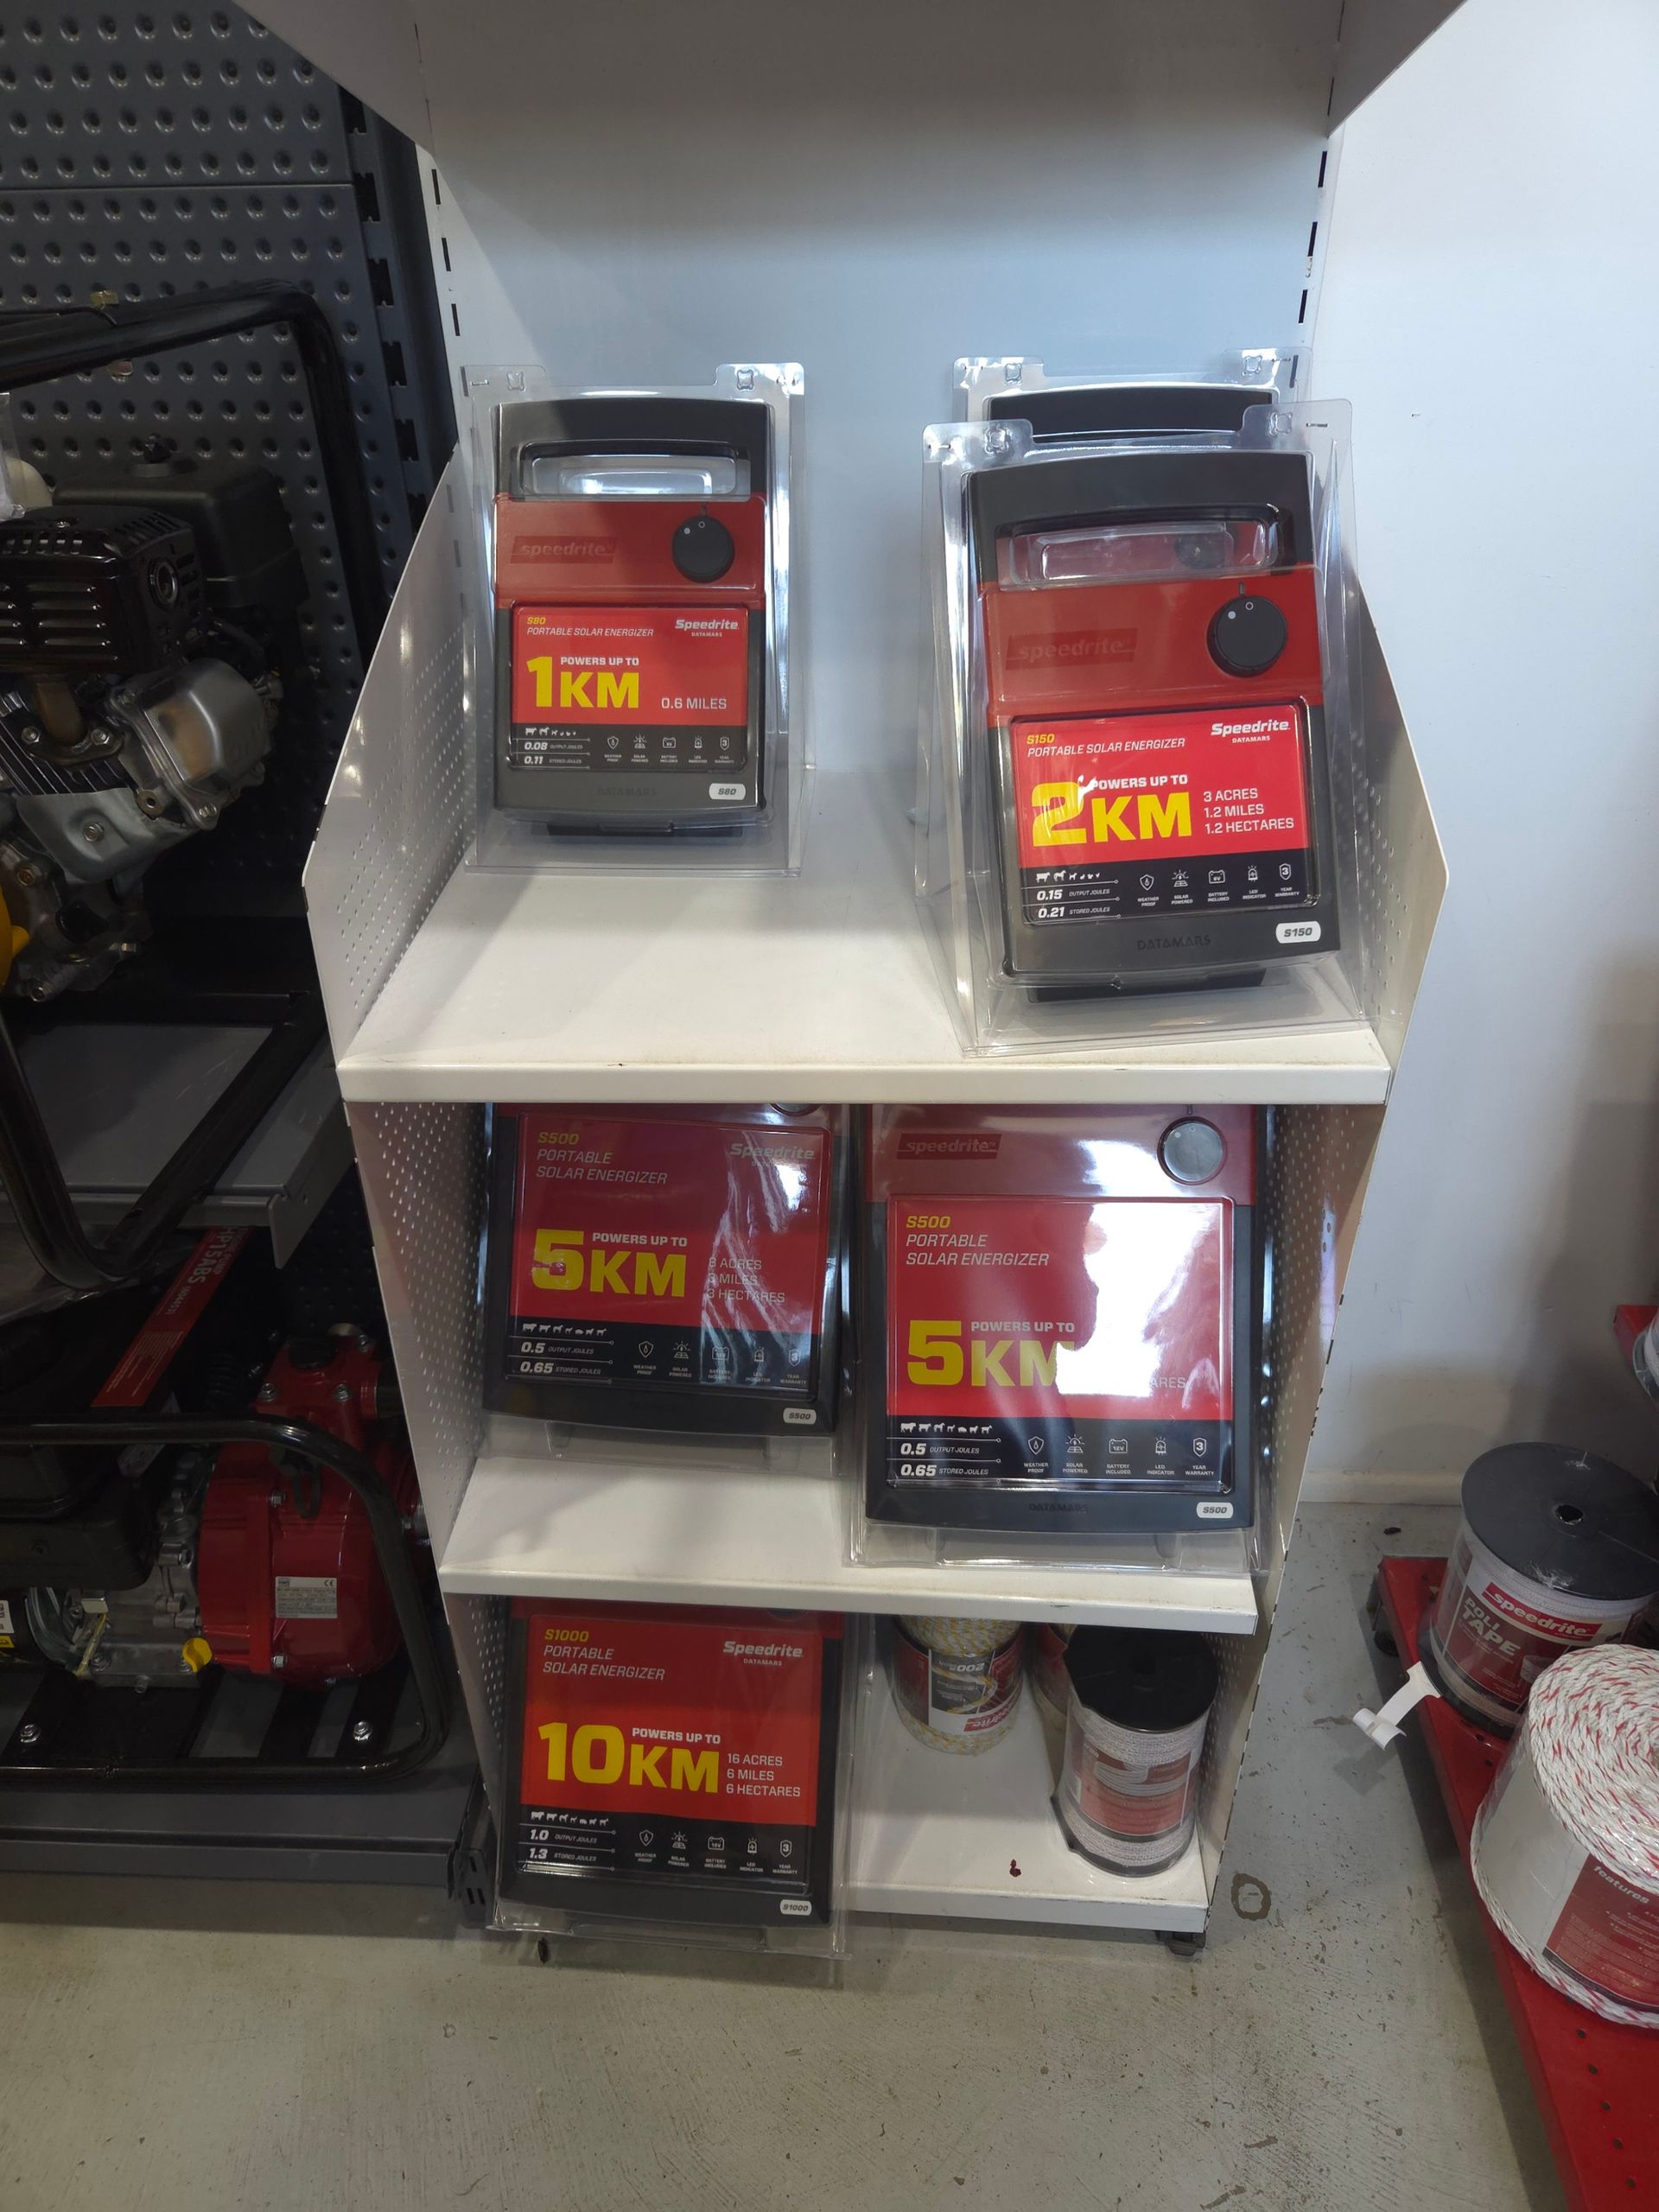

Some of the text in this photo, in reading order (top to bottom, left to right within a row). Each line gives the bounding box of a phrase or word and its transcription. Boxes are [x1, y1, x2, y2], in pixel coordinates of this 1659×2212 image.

[522, 543, 606, 559] speedrite
[527, 616, 546, 626] S80
[675, 619, 740, 632] Speedrite
[527, 627, 572, 636] PORTABLE
[605, 628, 654, 637] ENERGIZER
[1018, 637, 1123, 663] speedrite
[561, 657, 639, 666] POWERS UP TO
[661, 697, 727, 709] 0.6 MILES
[1211, 720, 1290, 737] Speedrite
[1027, 734, 1055, 744] S150
[524, 741, 548, 751] 0.08
[1027, 738, 1185, 758] PORTABLE SOLAR ENERGIZER
[524, 755, 543, 765] 0.11
[1092, 774, 1188, 791] POWERS UP TO
[1204, 788, 1258, 802] 3 ACRES
[1204, 804, 1264, 818] 1.2 MILES
[1205, 817, 1294, 835] 1.2 HECTARES
[1281, 867, 1289, 875] 3
[1036, 889, 1063, 901] 0.15
[1038, 906, 1065, 918] 0.21
[1283, 927, 1313, 938] S150
[1137, 934, 1211, 950] DATAMARS
[537, 1132, 580, 1145] S500
[730, 1142, 815, 1160] Speedrite
[906, 1139, 989, 1154] speedrite
[537, 1148, 613, 1164] PORTABLE
[536, 1166, 668, 1185] SOLAR ENERGIZER
[906, 1215, 951, 1229] S500
[592, 1232, 688, 1247] POWERS UP TO
[906, 1234, 988, 1247] PORTABLE
[709, 1257, 762, 1270] 8 ACRES
[906, 1252, 1050, 1266] SOLAR ENERGIZER
[708, 1272, 758, 1285] 3 MILES
[707, 1288, 785, 1303] 3 HECTARES
[971, 1321, 1075, 1332] POWERS UP TO
[520, 1342, 594, 1355] 0.5 OUTPUT JOULES
[791, 1352, 798, 1361] 3
[519, 1361, 555, 1374] 0.65
[788, 1411, 811, 1420] S500
[900, 1442, 927, 1455] 0.5
[1196, 1442, 1204, 1452] 3
[900, 1464, 938, 1477] 0.65
[1465, 1597, 1500, 1631] POLI
[1493, 1593, 1588, 1635] speedrite
[544, 1629, 589, 1642] S1000
[1462, 1605, 1521, 1656] TAPE
[543, 1645, 614, 1660] PORTABLE
[722, 1641, 804, 1658] Speedrite
[543, 1662, 665, 1681] SOLAR ENERGIZER
[632, 1727, 721, 1745] POWERS UP TO
[727, 1752, 783, 1766] 16 ACRES
[727, 1769, 774, 1781] 6 MILES
[726, 1783, 801, 1797] 6 HECTARES
[530, 1828, 550, 1840] 1.0
[529, 1847, 549, 1859] 1.3
[782, 1844, 789, 1853] 3
[1593, 1866, 1650, 1904] features
